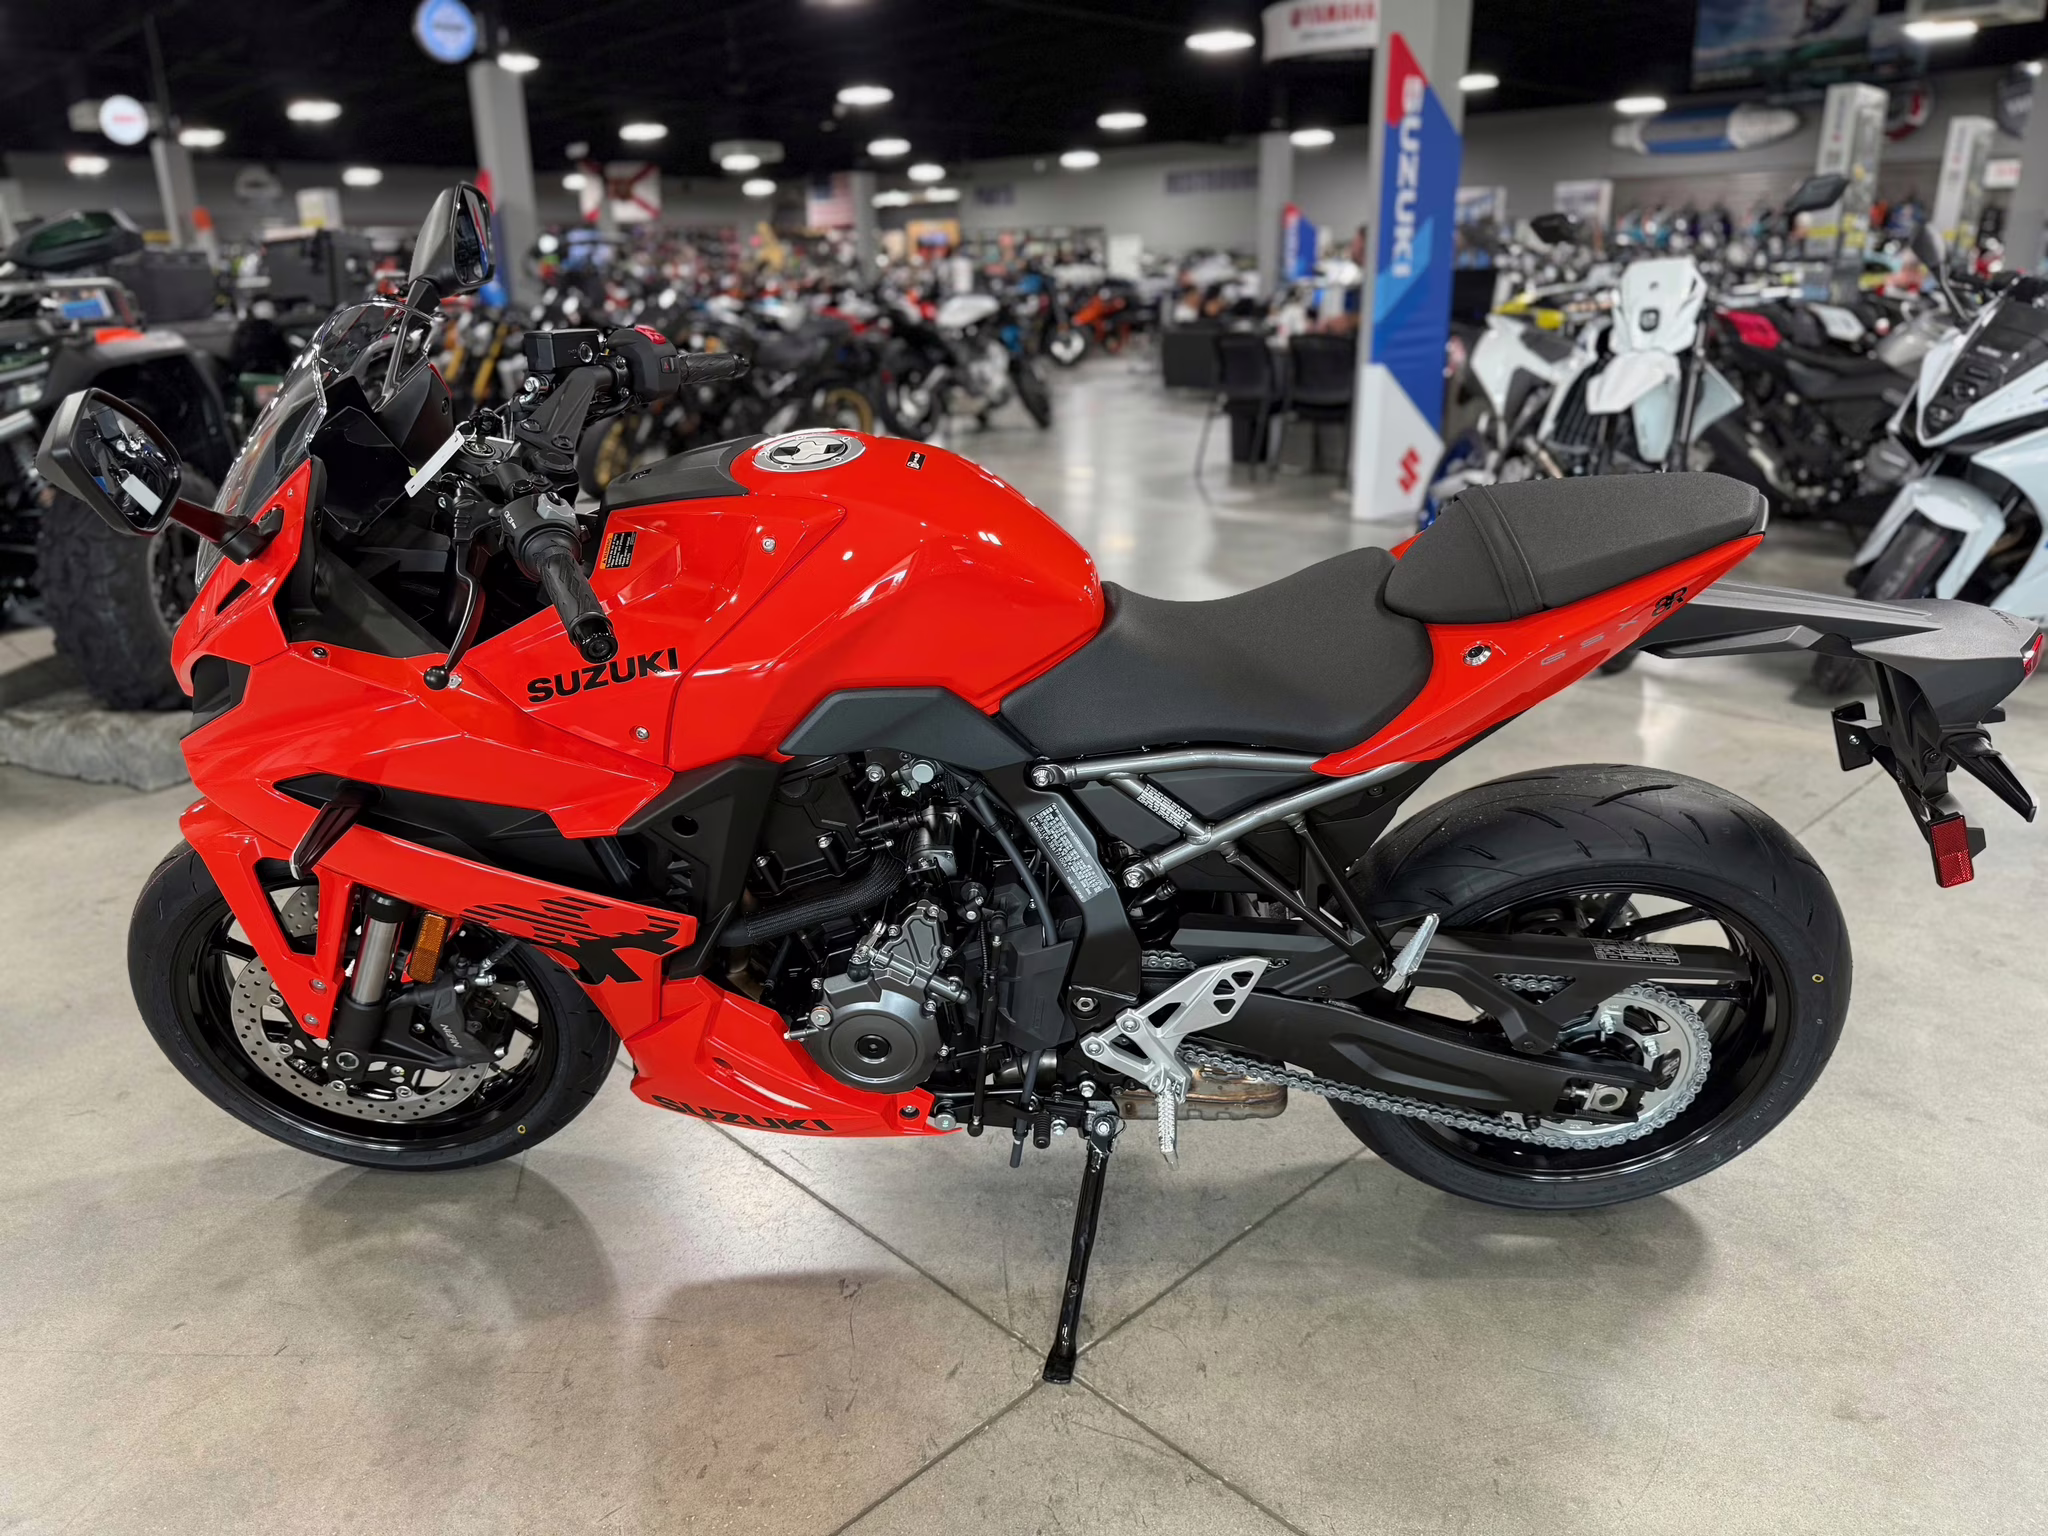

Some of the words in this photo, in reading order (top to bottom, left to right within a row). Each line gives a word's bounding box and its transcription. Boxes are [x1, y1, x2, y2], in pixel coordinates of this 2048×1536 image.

[1391, 73, 1425, 279] SUZUKI
[527, 647, 679, 704] SUZUKI
[651, 1094, 835, 1131] SUZUKI
